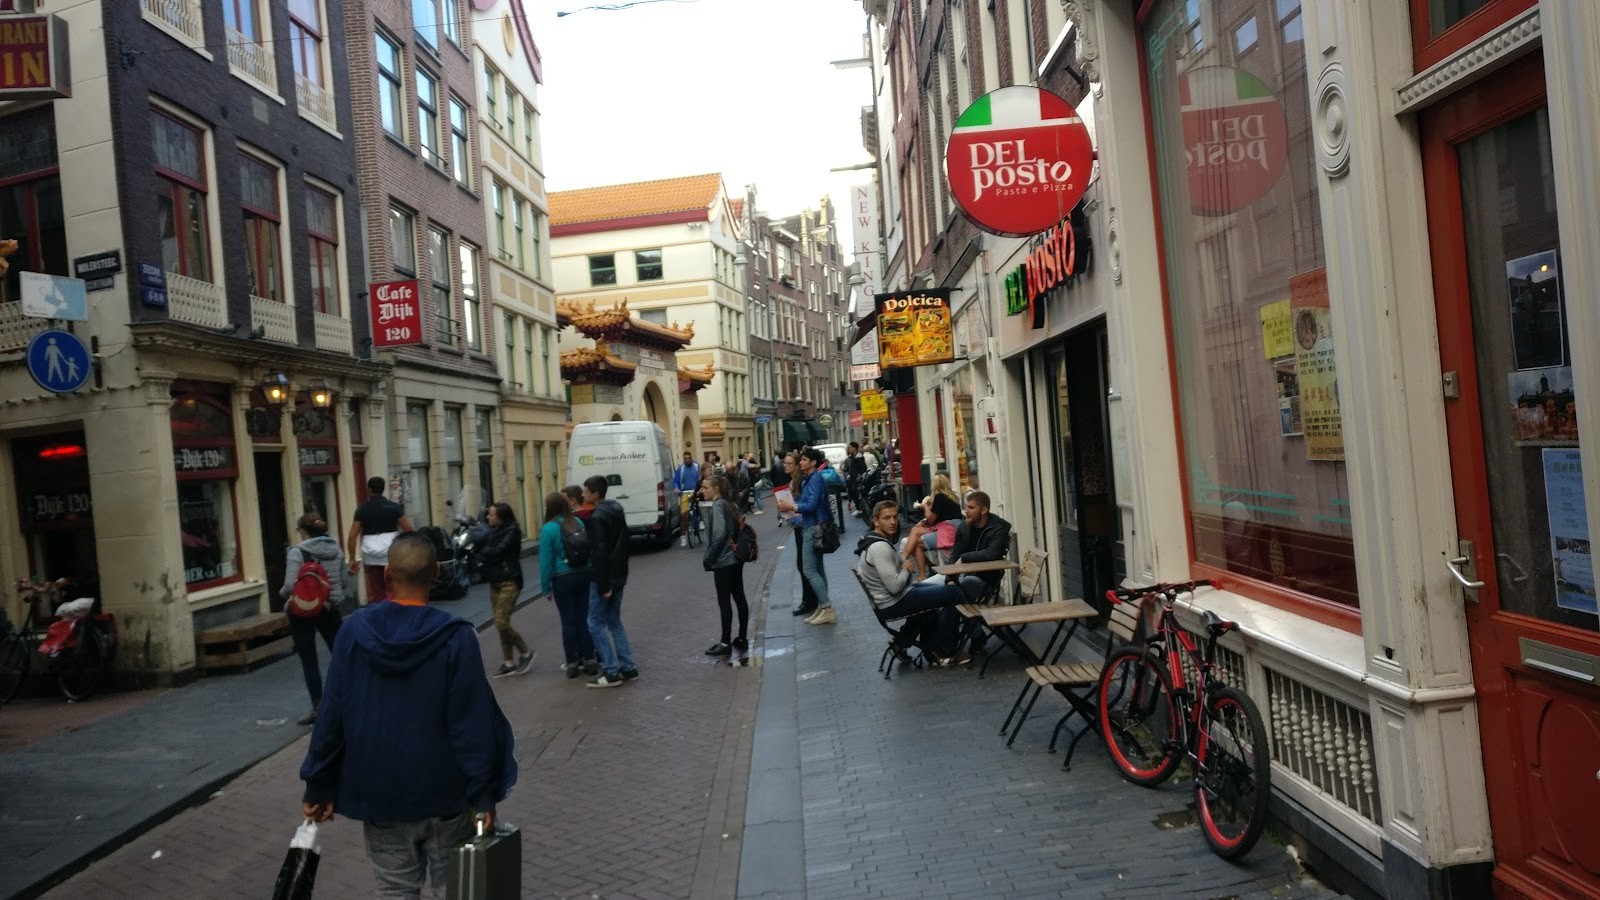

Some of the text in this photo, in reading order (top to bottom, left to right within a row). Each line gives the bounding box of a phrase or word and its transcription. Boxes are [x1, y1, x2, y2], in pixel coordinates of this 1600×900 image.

[0, 21, 46, 44] RANT
[968, 139, 1036, 167] DEL
[970, 158, 1073, 202] posto
[996, 187, 1028, 197] Pasta
[1043, 183, 1074, 193] Pizza
[857, 186, 871, 228] NEW
[861, 241, 875, 297] KING
[376, 284, 412, 302] Cafe
[884, 293, 942, 311] Dolcica
[377, 302, 414, 324] Dijk
[384, 326, 411, 341] 120
[620, 452, 647, 460] Anker
[67, 493, 90, 512] 120
